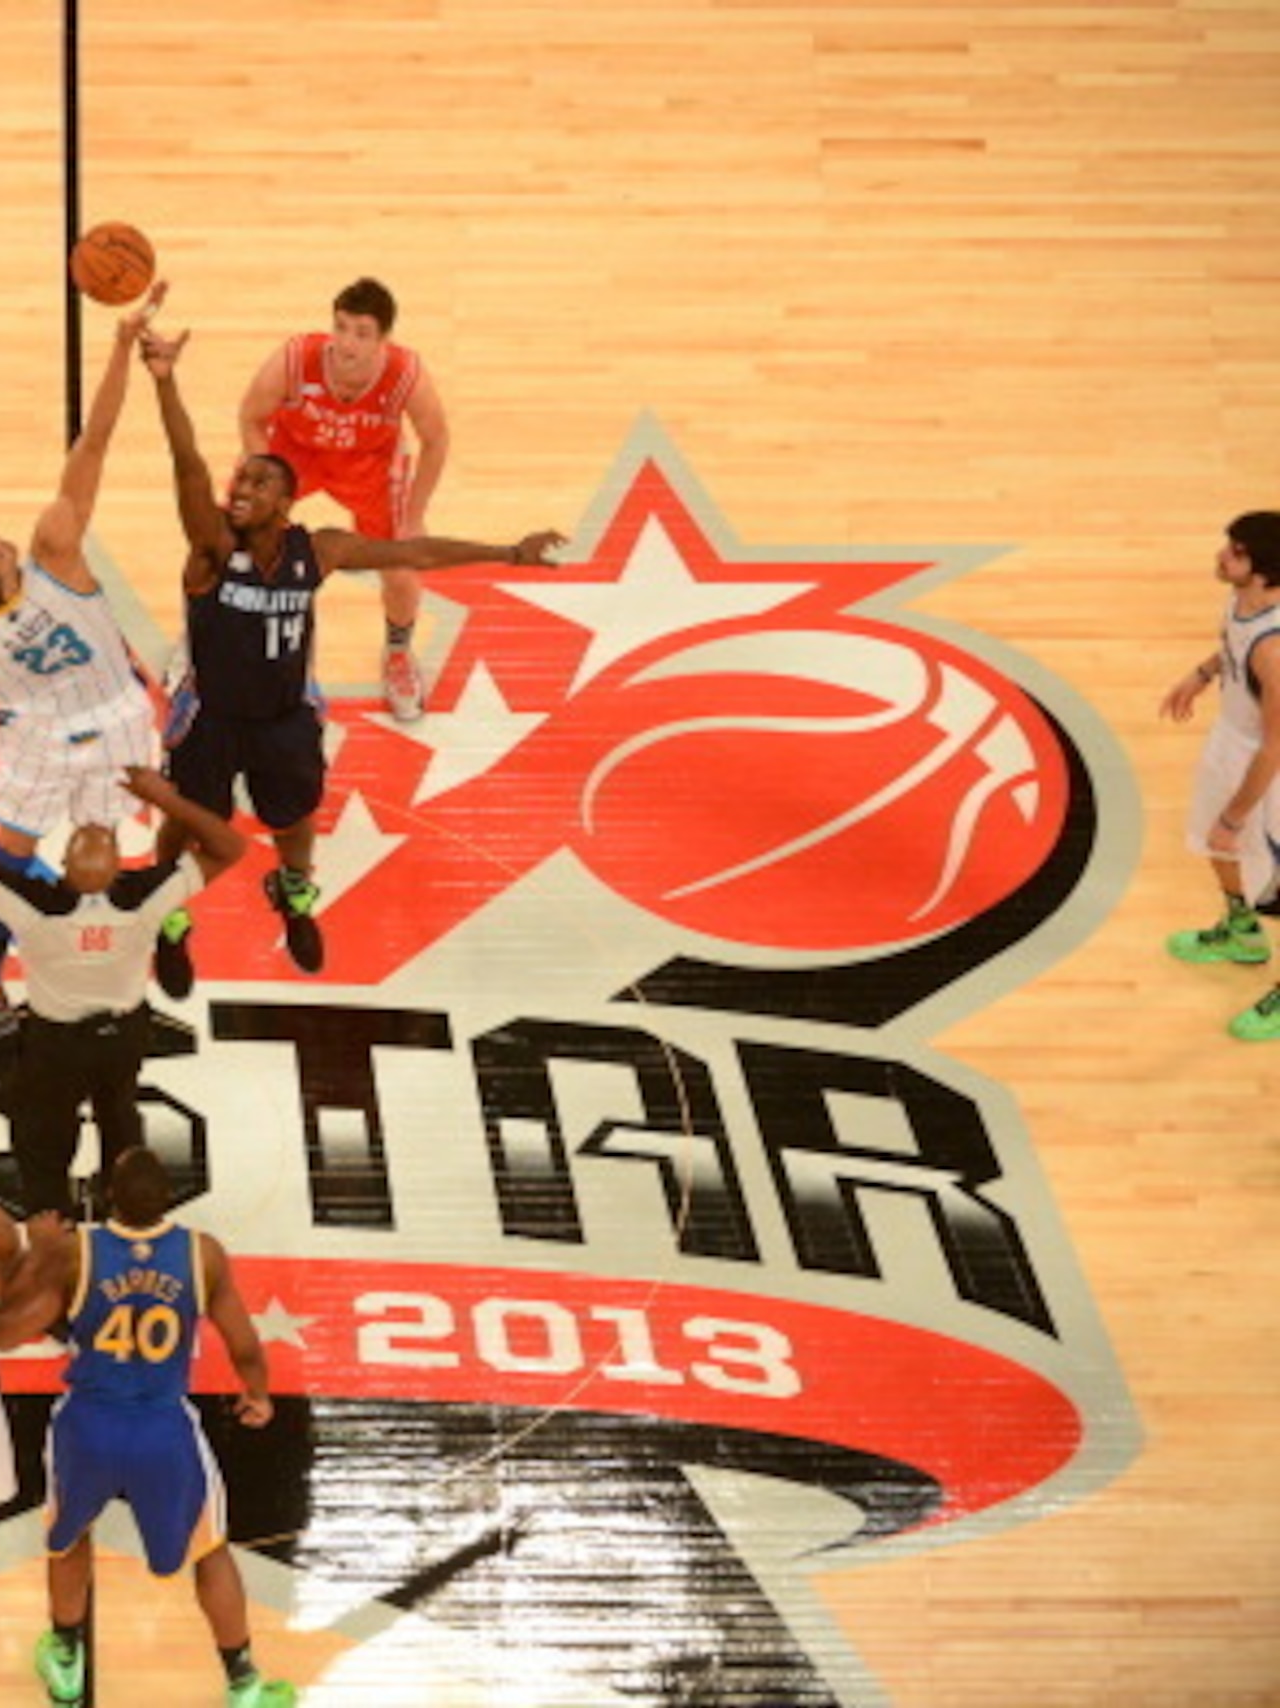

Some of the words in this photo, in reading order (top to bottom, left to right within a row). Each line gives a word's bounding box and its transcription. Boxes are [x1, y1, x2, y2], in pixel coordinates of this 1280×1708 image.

[13, 622, 93, 675] 23
[264, 612, 305, 660] 14
[93, 1304, 180, 1364] 40
[354, 1291, 803, 1398] 2013
